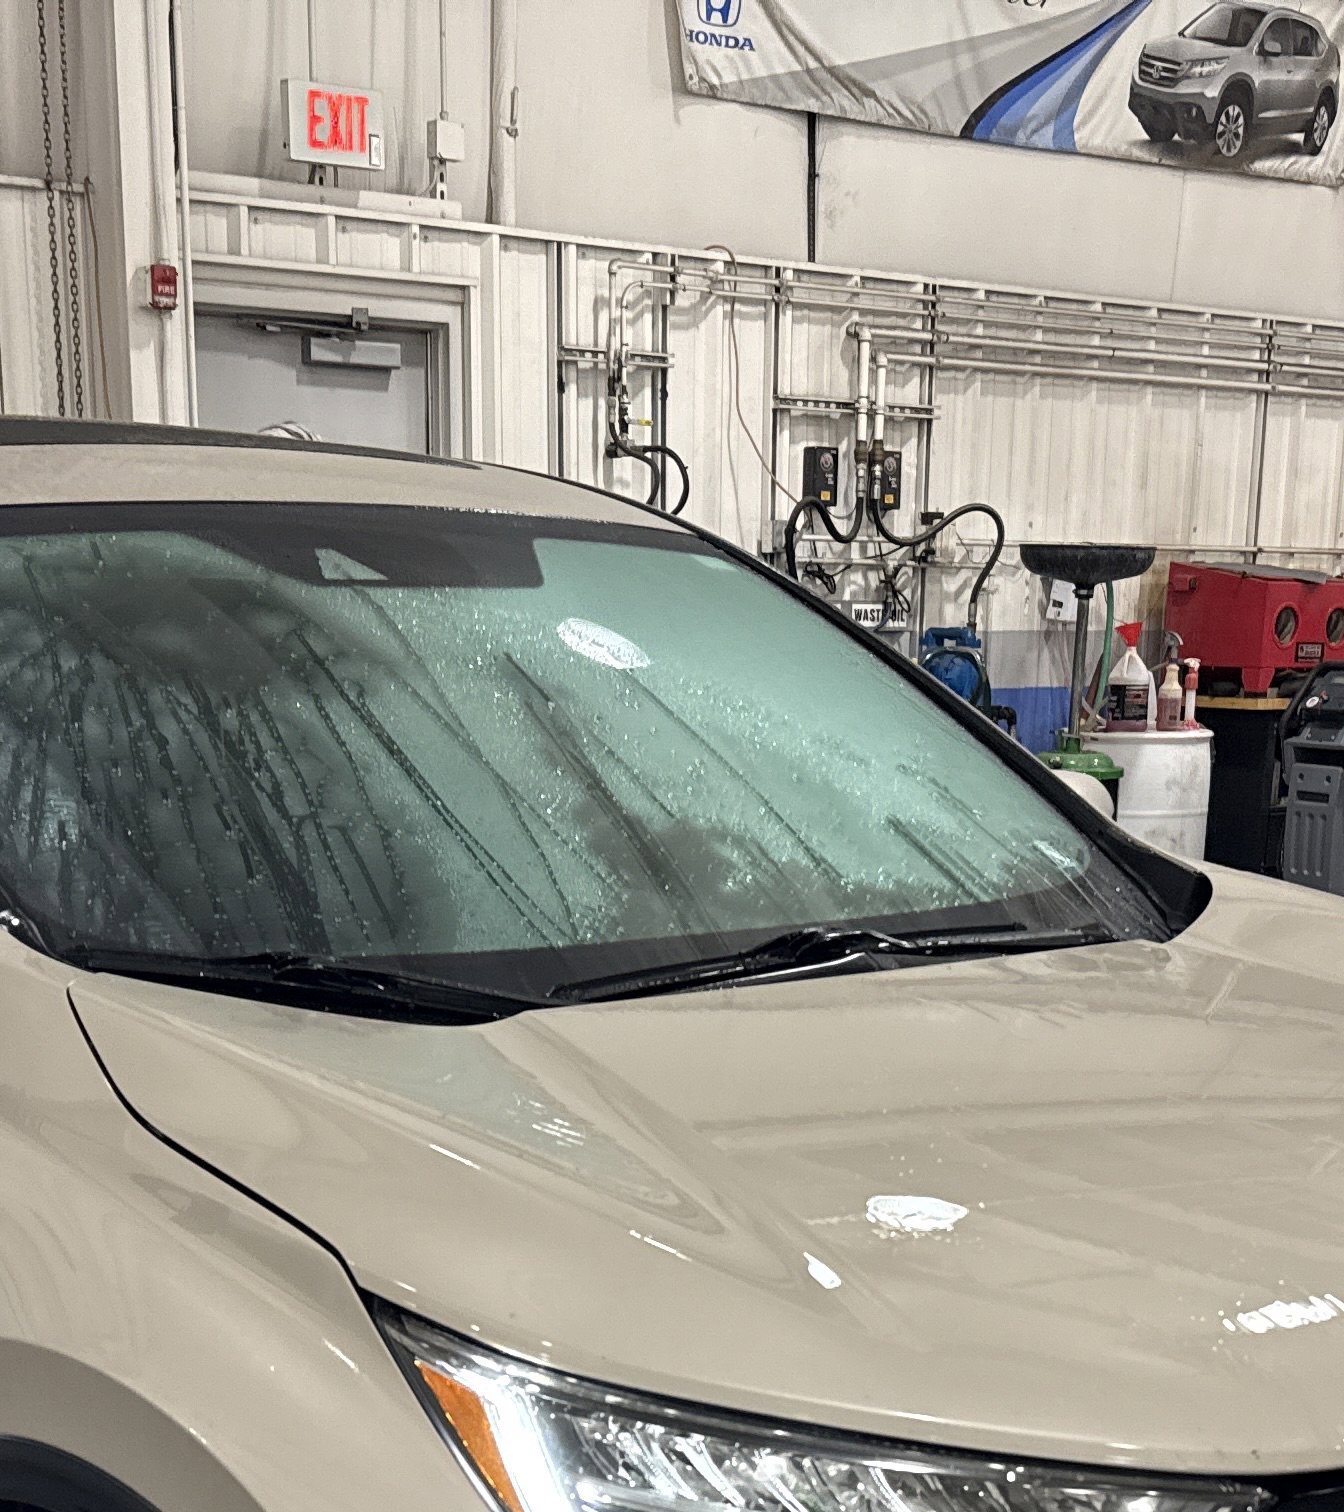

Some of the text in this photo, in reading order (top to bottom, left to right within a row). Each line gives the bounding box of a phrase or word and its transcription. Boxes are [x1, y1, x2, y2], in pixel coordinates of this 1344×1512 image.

[686, 29, 755, 51] HONDA
[307, 88, 369, 155] EXIT
[854, 608, 886, 622] WAST
